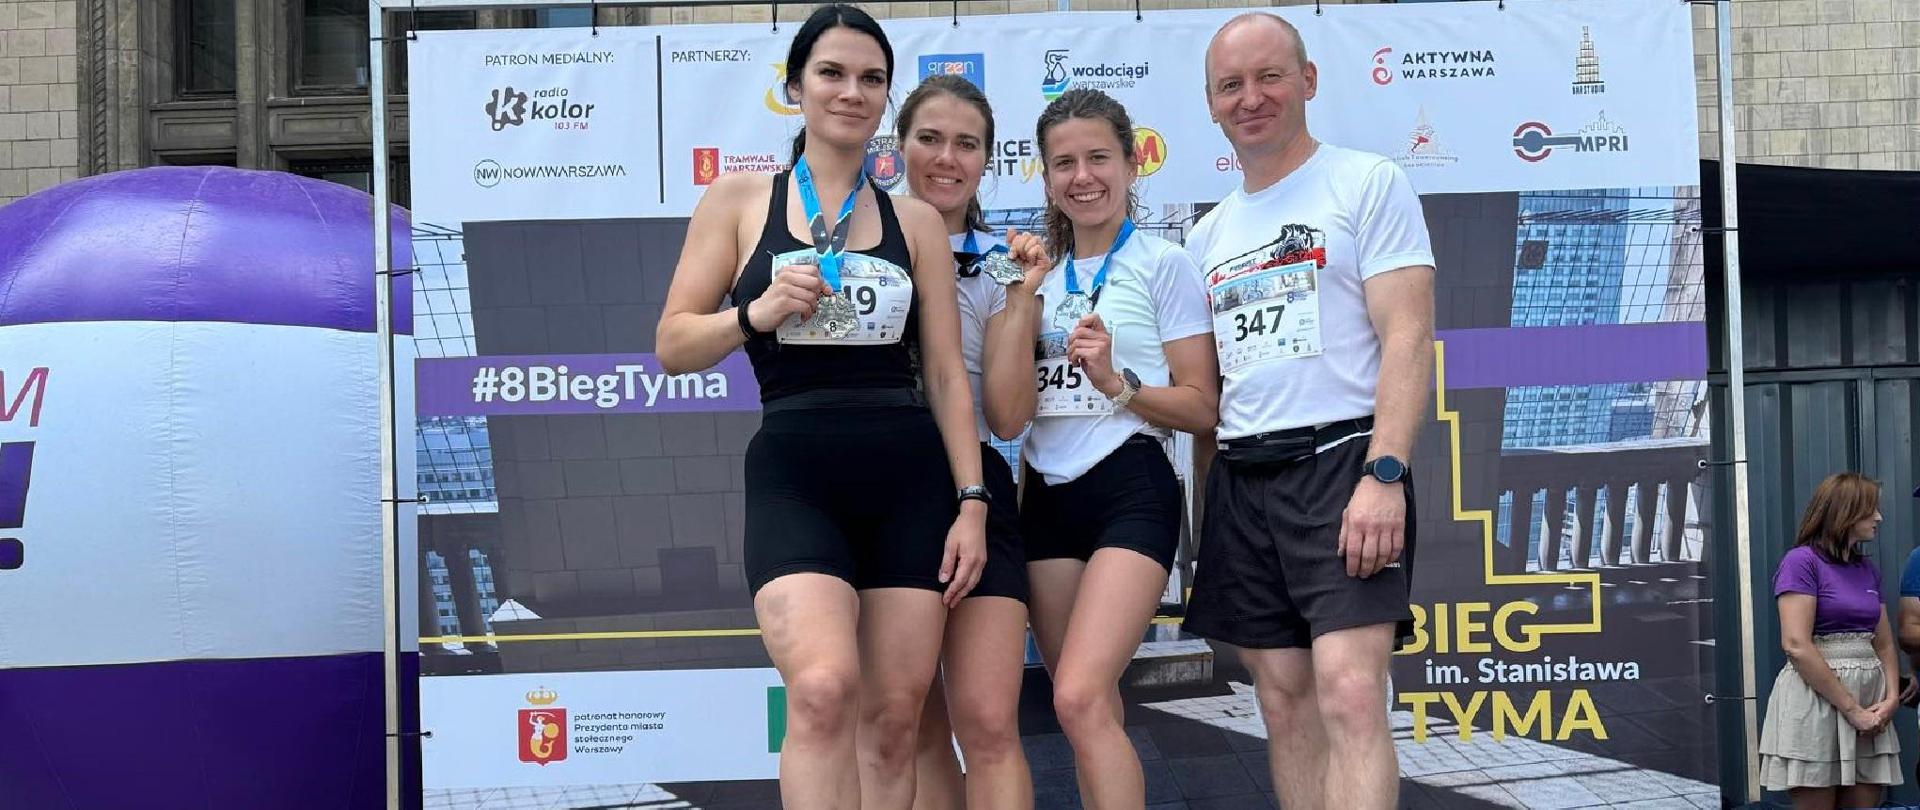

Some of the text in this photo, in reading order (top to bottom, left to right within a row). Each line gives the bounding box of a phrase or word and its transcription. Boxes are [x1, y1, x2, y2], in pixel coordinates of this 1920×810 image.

[485, 51, 615, 66] PATRON MEDIALNY:
[671, 49, 751, 63] PARTNERZY:
[1401, 50, 1495, 65] AKTYWNA
[1072, 61, 1149, 79] wodociągi
[1402, 67, 1496, 79] WARSZAWA
[1072, 79, 1136, 89] warszawskie
[533, 87, 569, 98] radio
[530, 99, 595, 120] kolor
[573, 121, 589, 130] FM
[1575, 135, 1629, 152] MPRI
[723, 154, 776, 164] TRAMWAJE
[1234, 304, 1285, 342] 347
[1037, 364, 1082, 393] 345
[472, 365, 728, 408] #8BiegTyma
[1426, 656, 1640, 684] im. Stanisława
[574, 712, 666, 722] patronat honorowy
[1399, 689, 1609, 744] TYMA
[574, 723, 628, 733] Prezydenta
[574, 735, 633, 744] stołecznego
[574, 745, 623, 754] Warszawy
